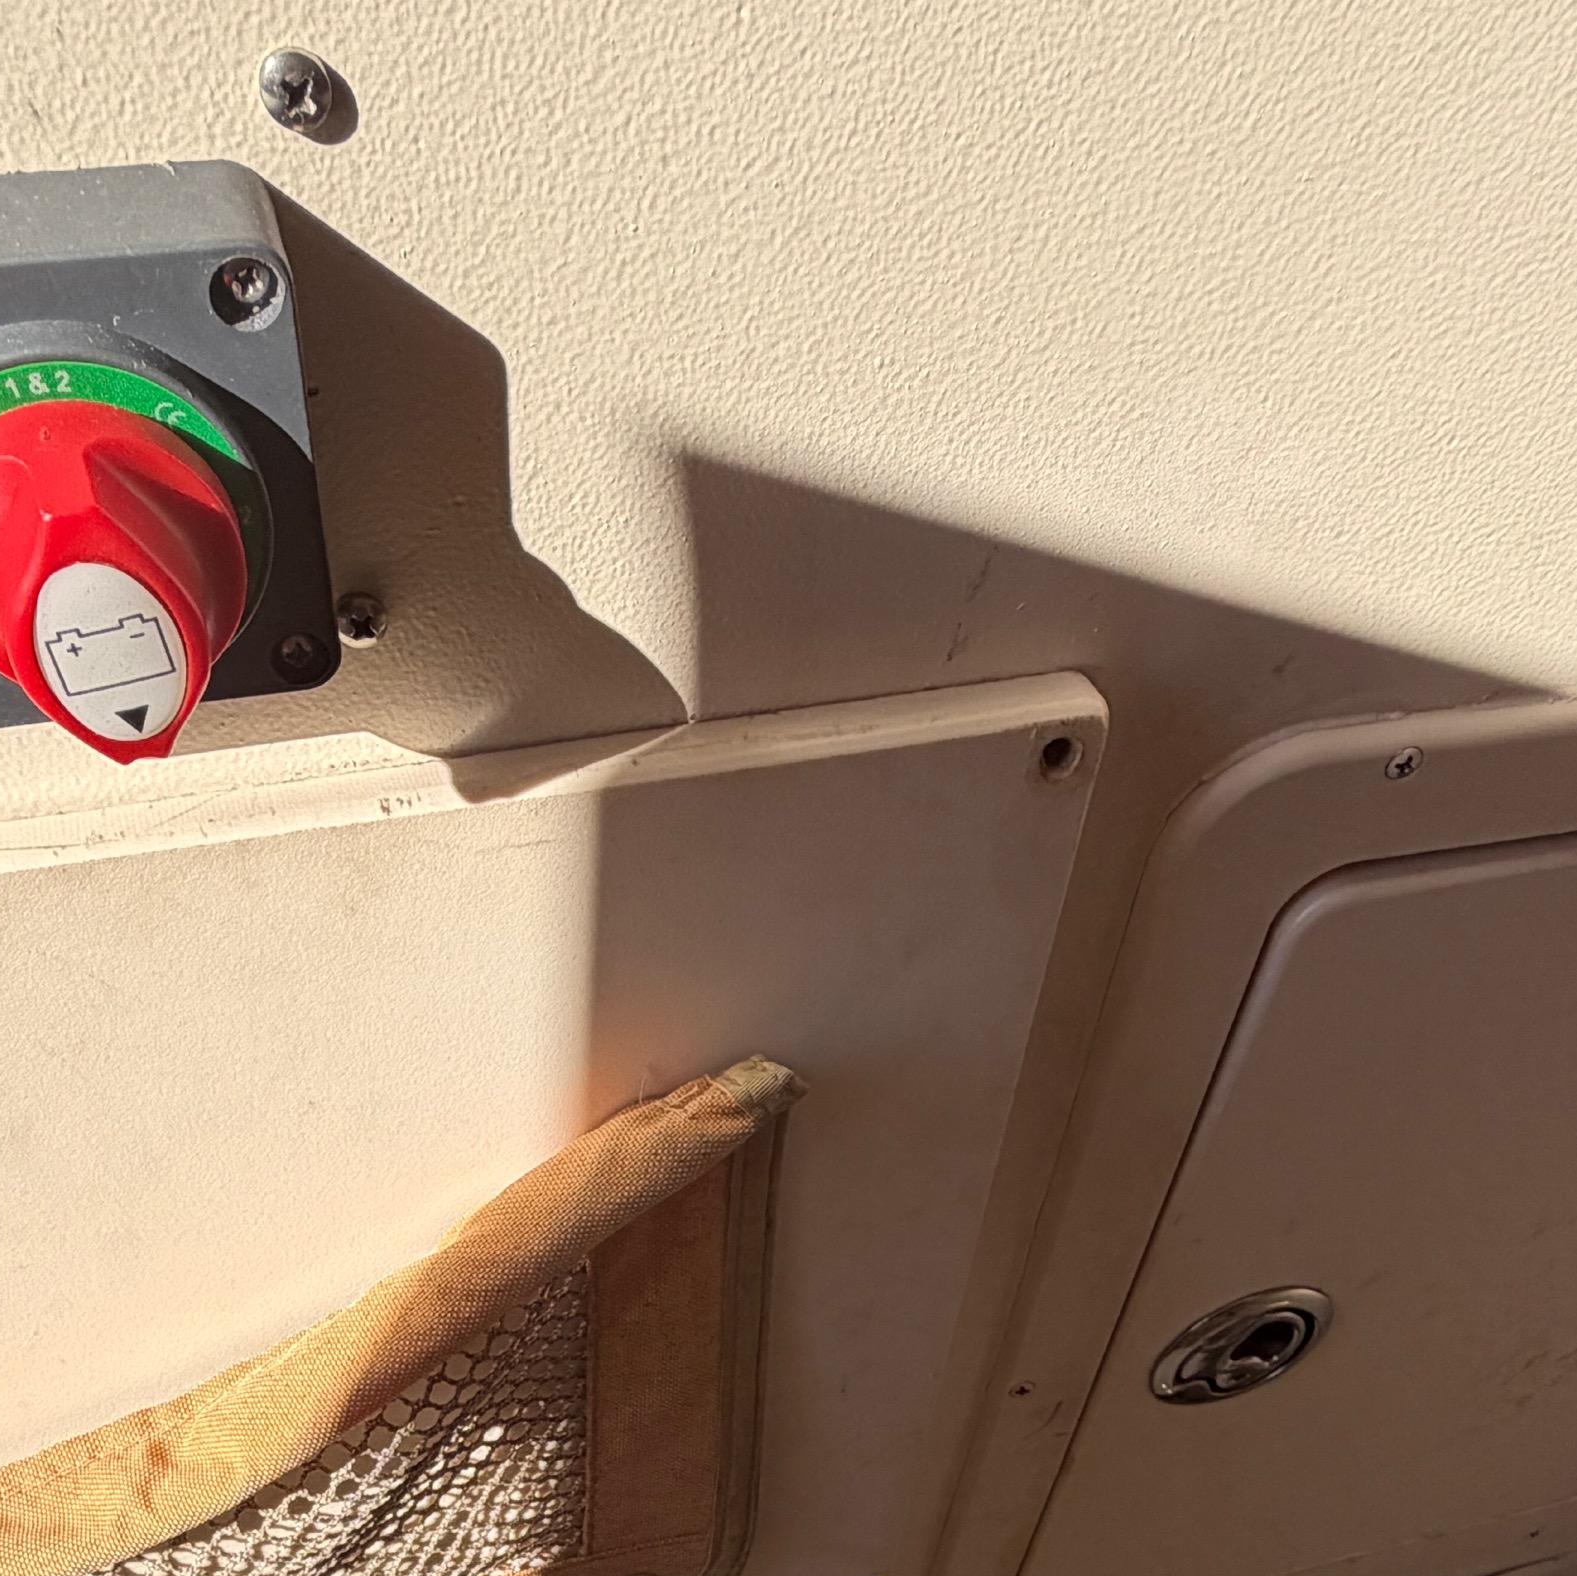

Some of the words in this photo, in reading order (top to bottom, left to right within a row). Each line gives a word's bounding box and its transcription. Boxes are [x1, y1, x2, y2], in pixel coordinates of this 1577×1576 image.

[5, 377, 21, 398] 1
[28, 372, 50, 395] &
[55, 370, 72, 393] 2
